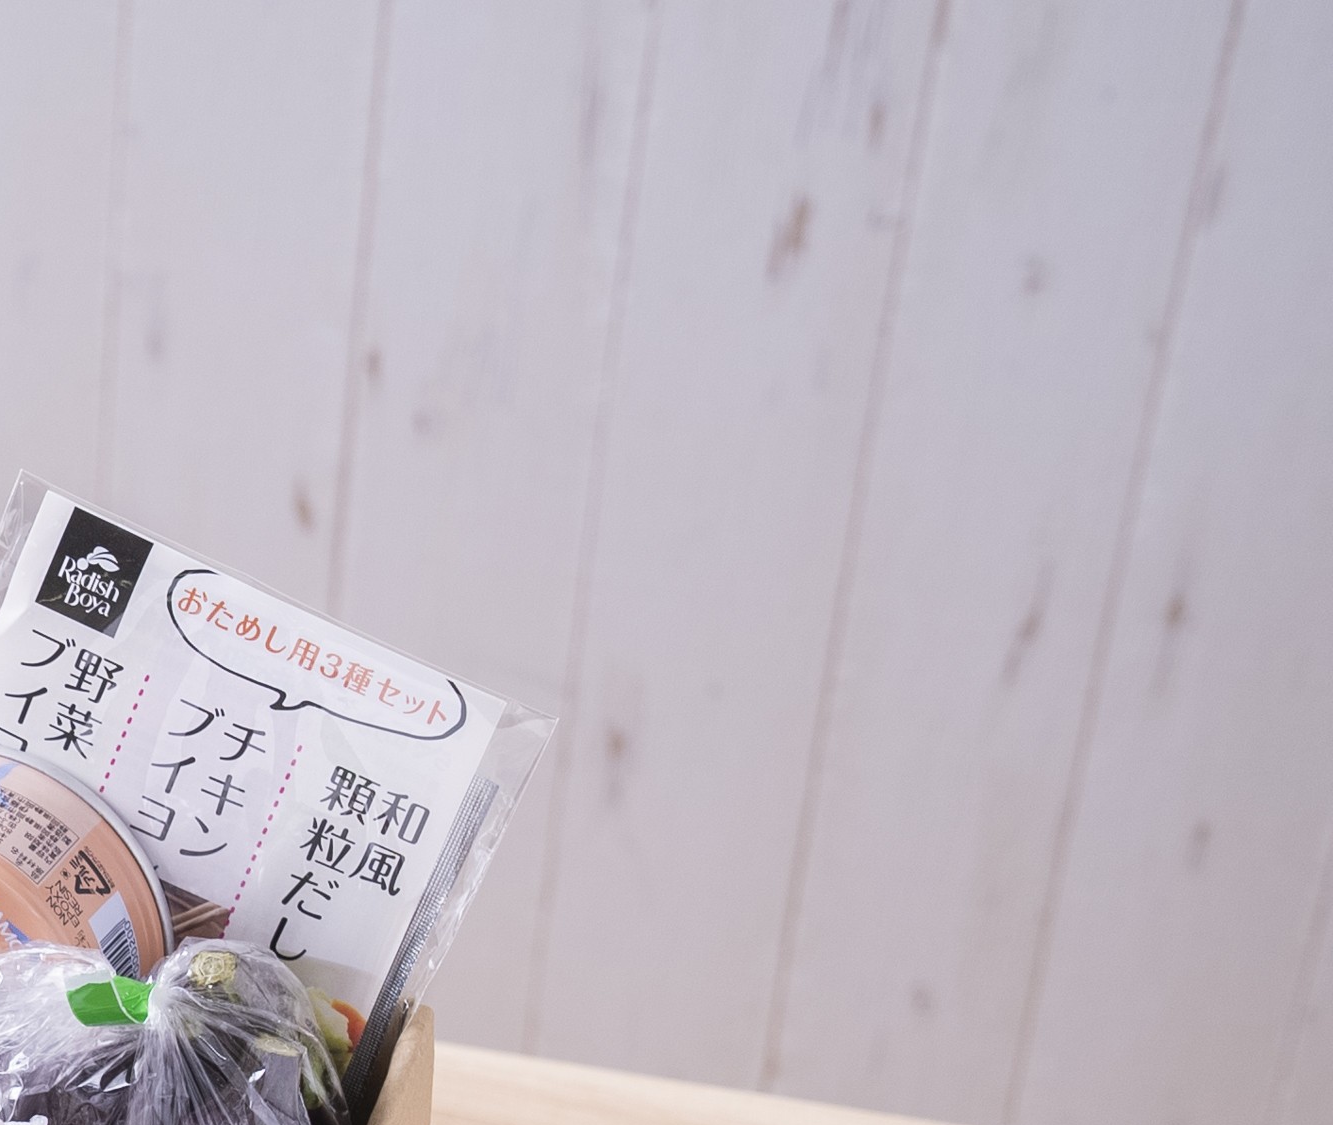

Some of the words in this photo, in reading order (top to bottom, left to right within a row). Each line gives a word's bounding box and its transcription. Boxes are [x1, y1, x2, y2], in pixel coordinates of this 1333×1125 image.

[57, 554, 122, 604] Radish
[64, 582, 111, 618] Boya
[177, 586, 448, 727] おためし用3種セット
[44, 648, 124, 760] 野菜
[129, 698, 226, 872] ブイヨ
[179, 723, 266, 857] チキン
[67, 853, 96, 887] アルミ
[269, 764, 376, 962] 顆粒だし
[348, 791, 431, 897] 和風
[44, 882, 82, 927] EPOXY
[44, 894, 70, 926] NON
[53, 878, 84, 916] RESIN
